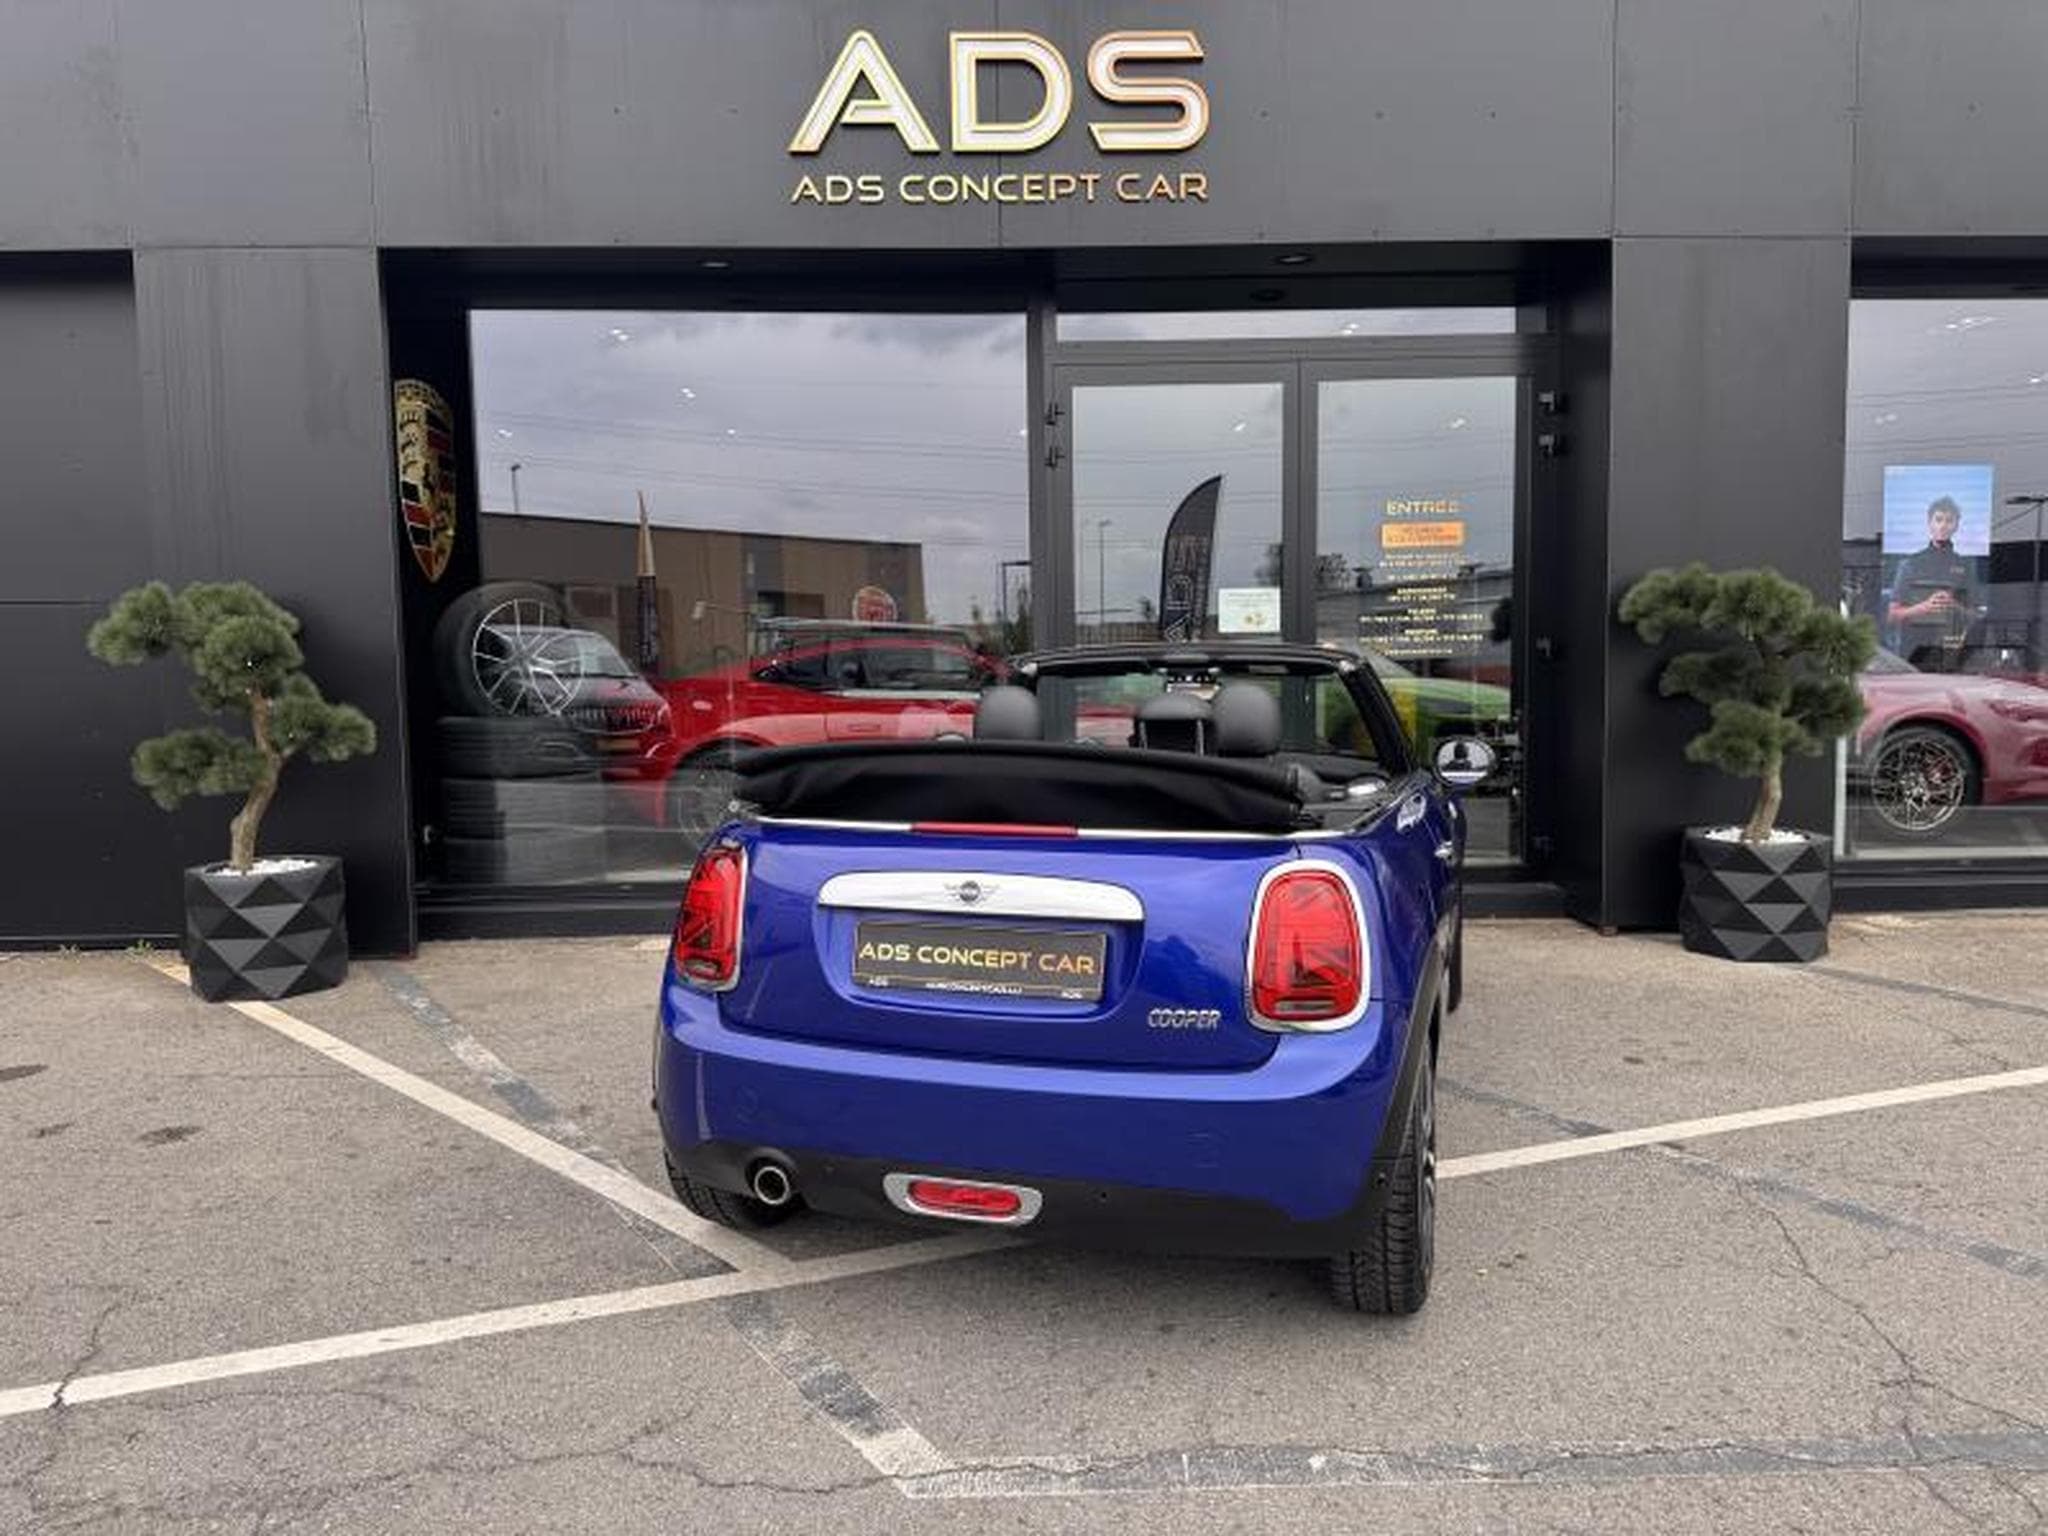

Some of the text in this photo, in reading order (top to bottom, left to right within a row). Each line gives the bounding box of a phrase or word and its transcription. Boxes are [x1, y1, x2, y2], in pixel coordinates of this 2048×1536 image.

[788, 29, 1210, 153] ADS
[791, 173, 1209, 203] ADS CONCEPT CAR
[859, 942, 1095, 975] ADS CONCEPT CAR
[1148, 1008, 1221, 1030] COOPER
